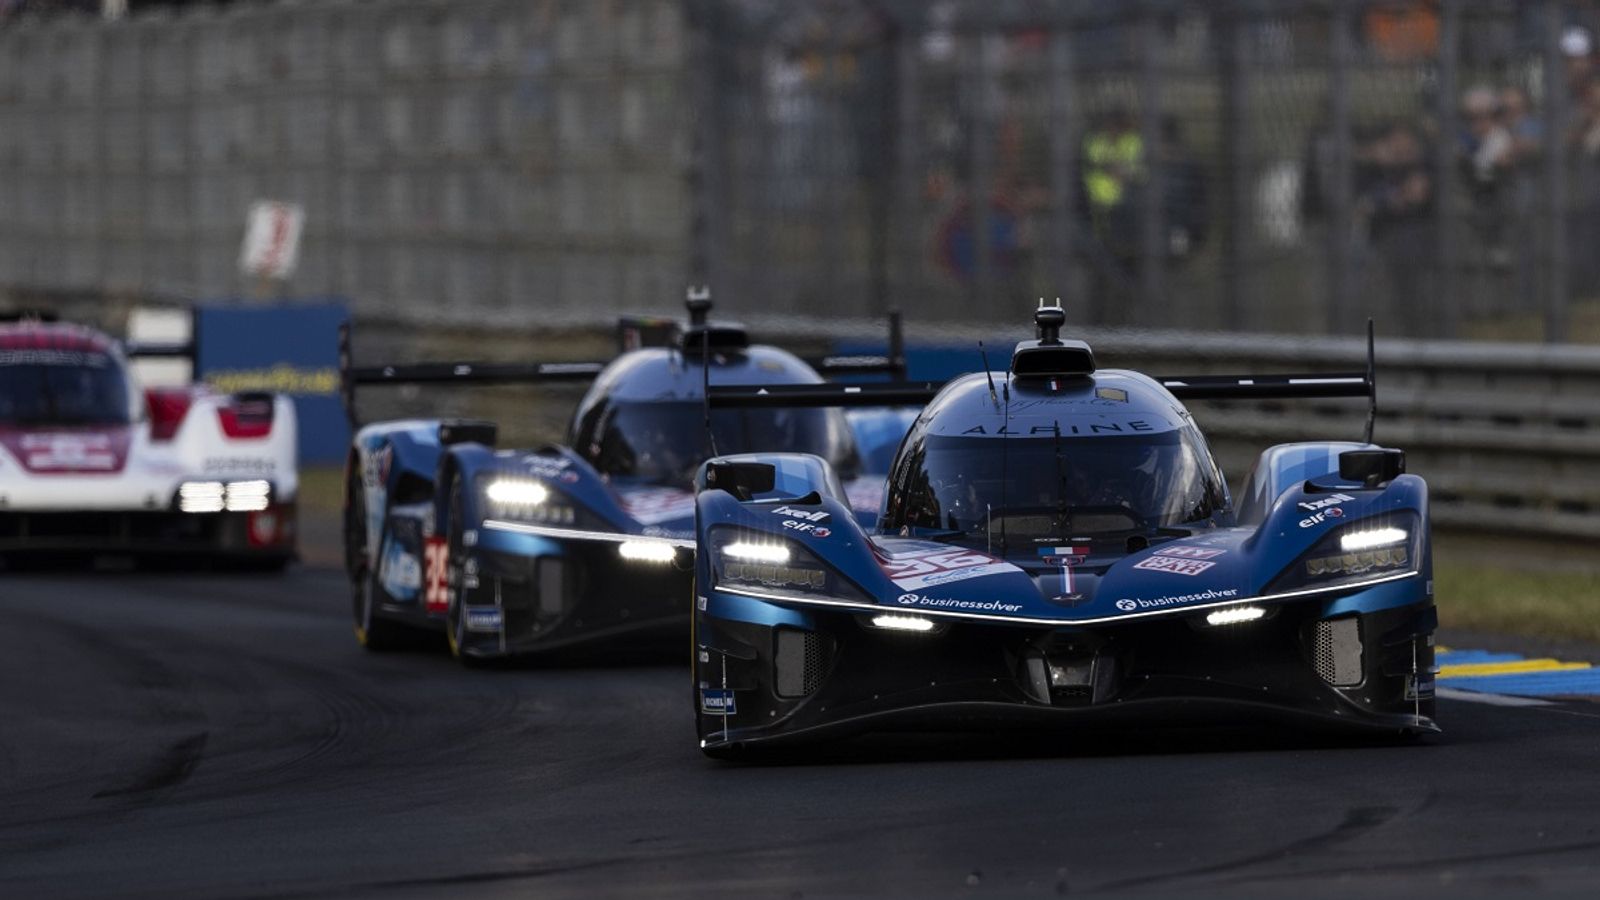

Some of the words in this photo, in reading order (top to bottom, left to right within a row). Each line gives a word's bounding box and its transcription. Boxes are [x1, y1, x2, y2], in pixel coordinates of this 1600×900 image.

[961, 420, 1154, 435] ALPINE
[919, 595, 1023, 613] businessolver
[1138, 588, 1238, 608] businessolver
